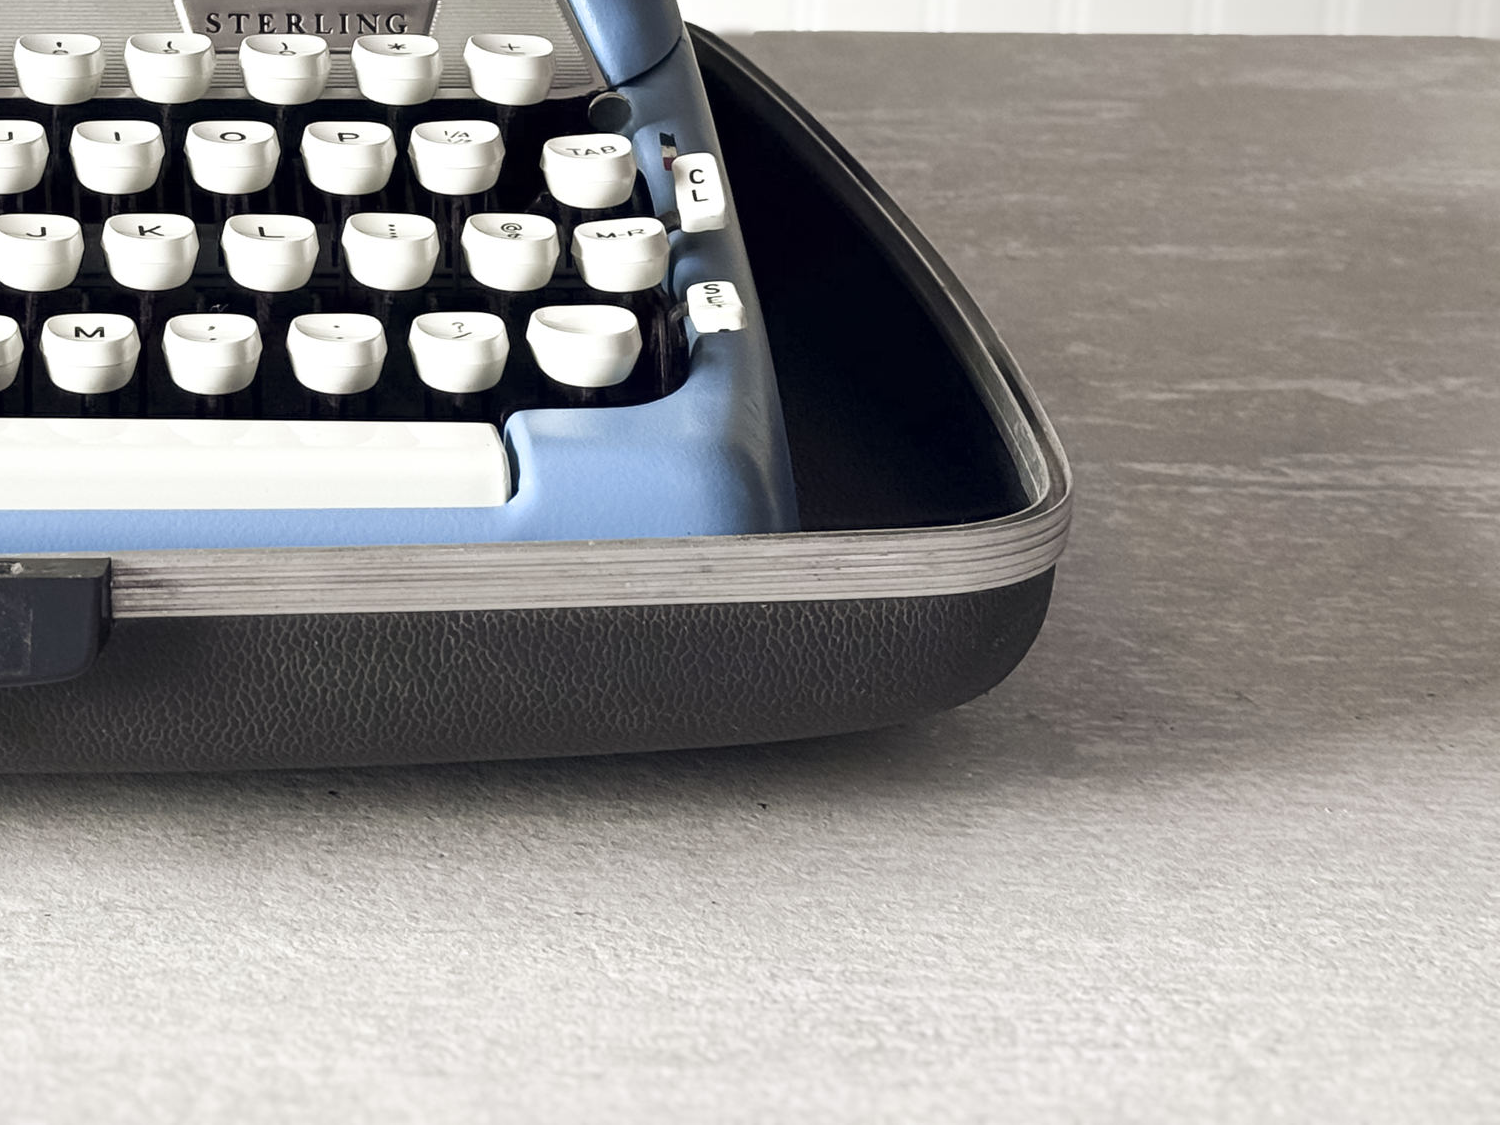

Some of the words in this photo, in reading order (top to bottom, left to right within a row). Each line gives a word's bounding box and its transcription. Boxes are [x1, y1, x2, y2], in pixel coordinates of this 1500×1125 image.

[205, 12, 408, 35] STERLING
[114, 131, 121, 142] I
[219, 131, 246, 142] O
[337, 132, 360, 142] P
[566, 145, 618, 156] TAB
[26, 226, 47, 238] J
[137, 225, 165, 236] K
[257, 226, 285, 238] L
[501, 222, 522, 233] @
[596, 228, 646, 239] M-R
[74, 326, 105, 338] M
